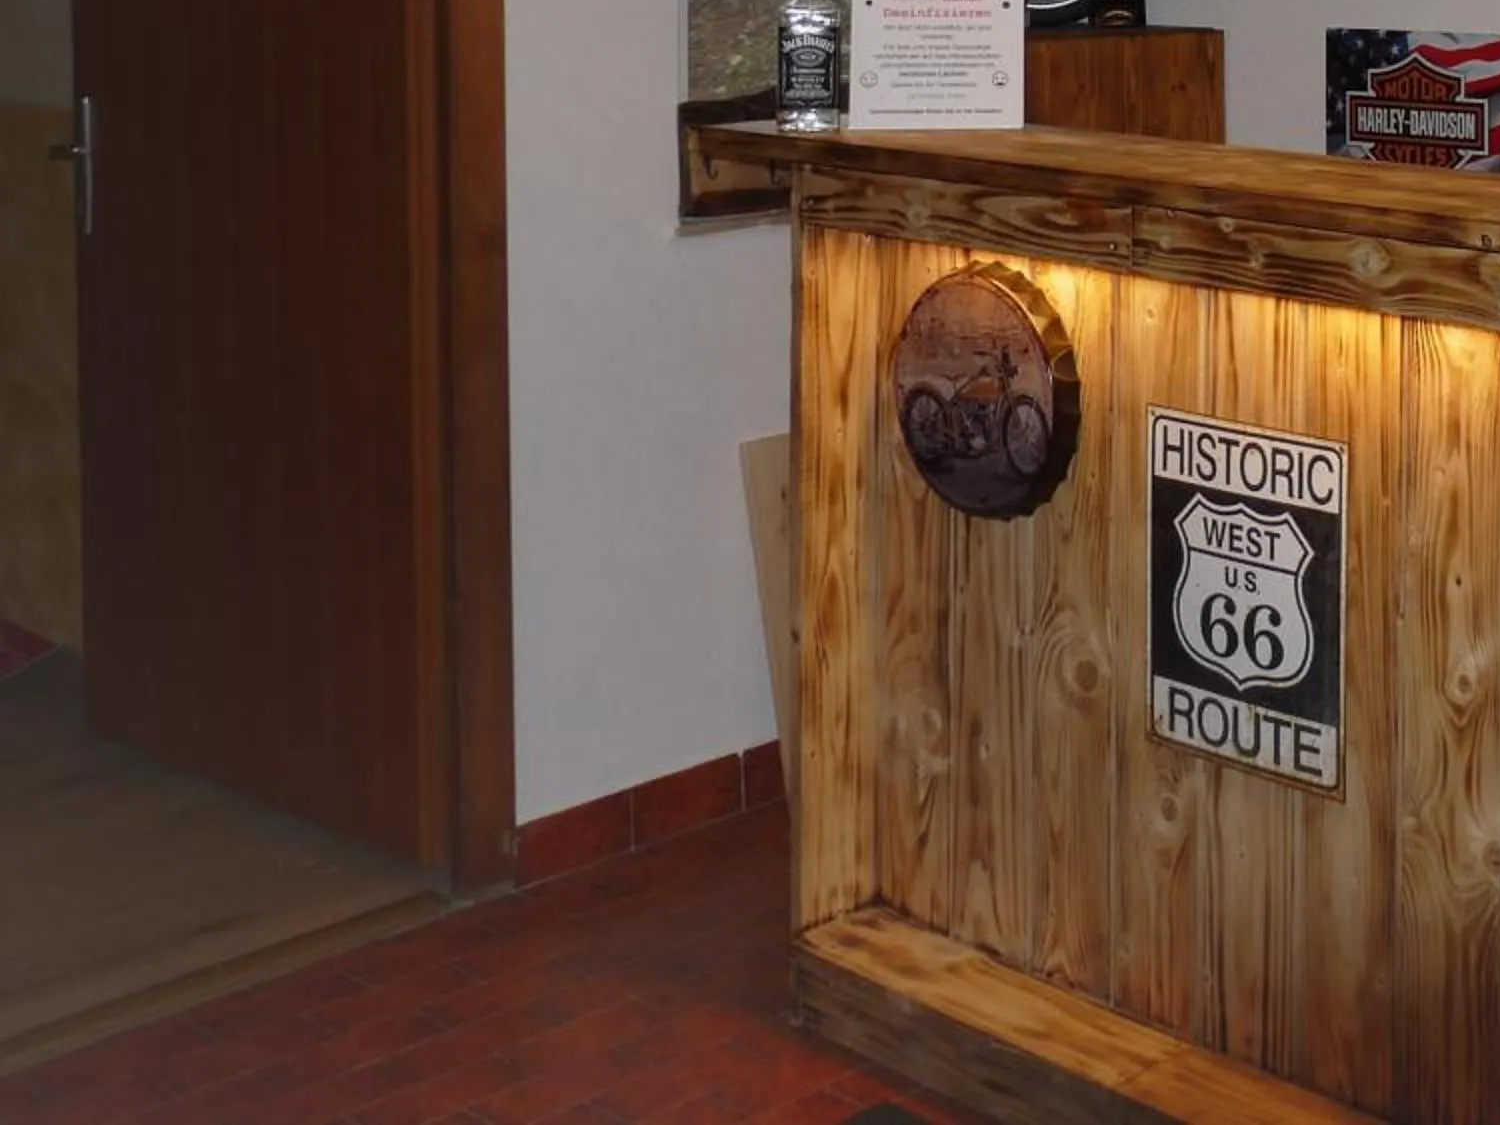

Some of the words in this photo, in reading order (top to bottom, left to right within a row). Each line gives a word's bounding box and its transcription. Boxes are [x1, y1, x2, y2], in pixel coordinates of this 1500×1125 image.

[1384, 69, 1449, 101] MOTOR
[1357, 105, 1478, 140] HARLEY-DAVIDSON
[1162, 424, 1335, 507] HISTORIC
[1202, 517, 1281, 561] WEST
[1200, 592, 1285, 671] 66
[1168, 685, 1324, 778] ROUTE
